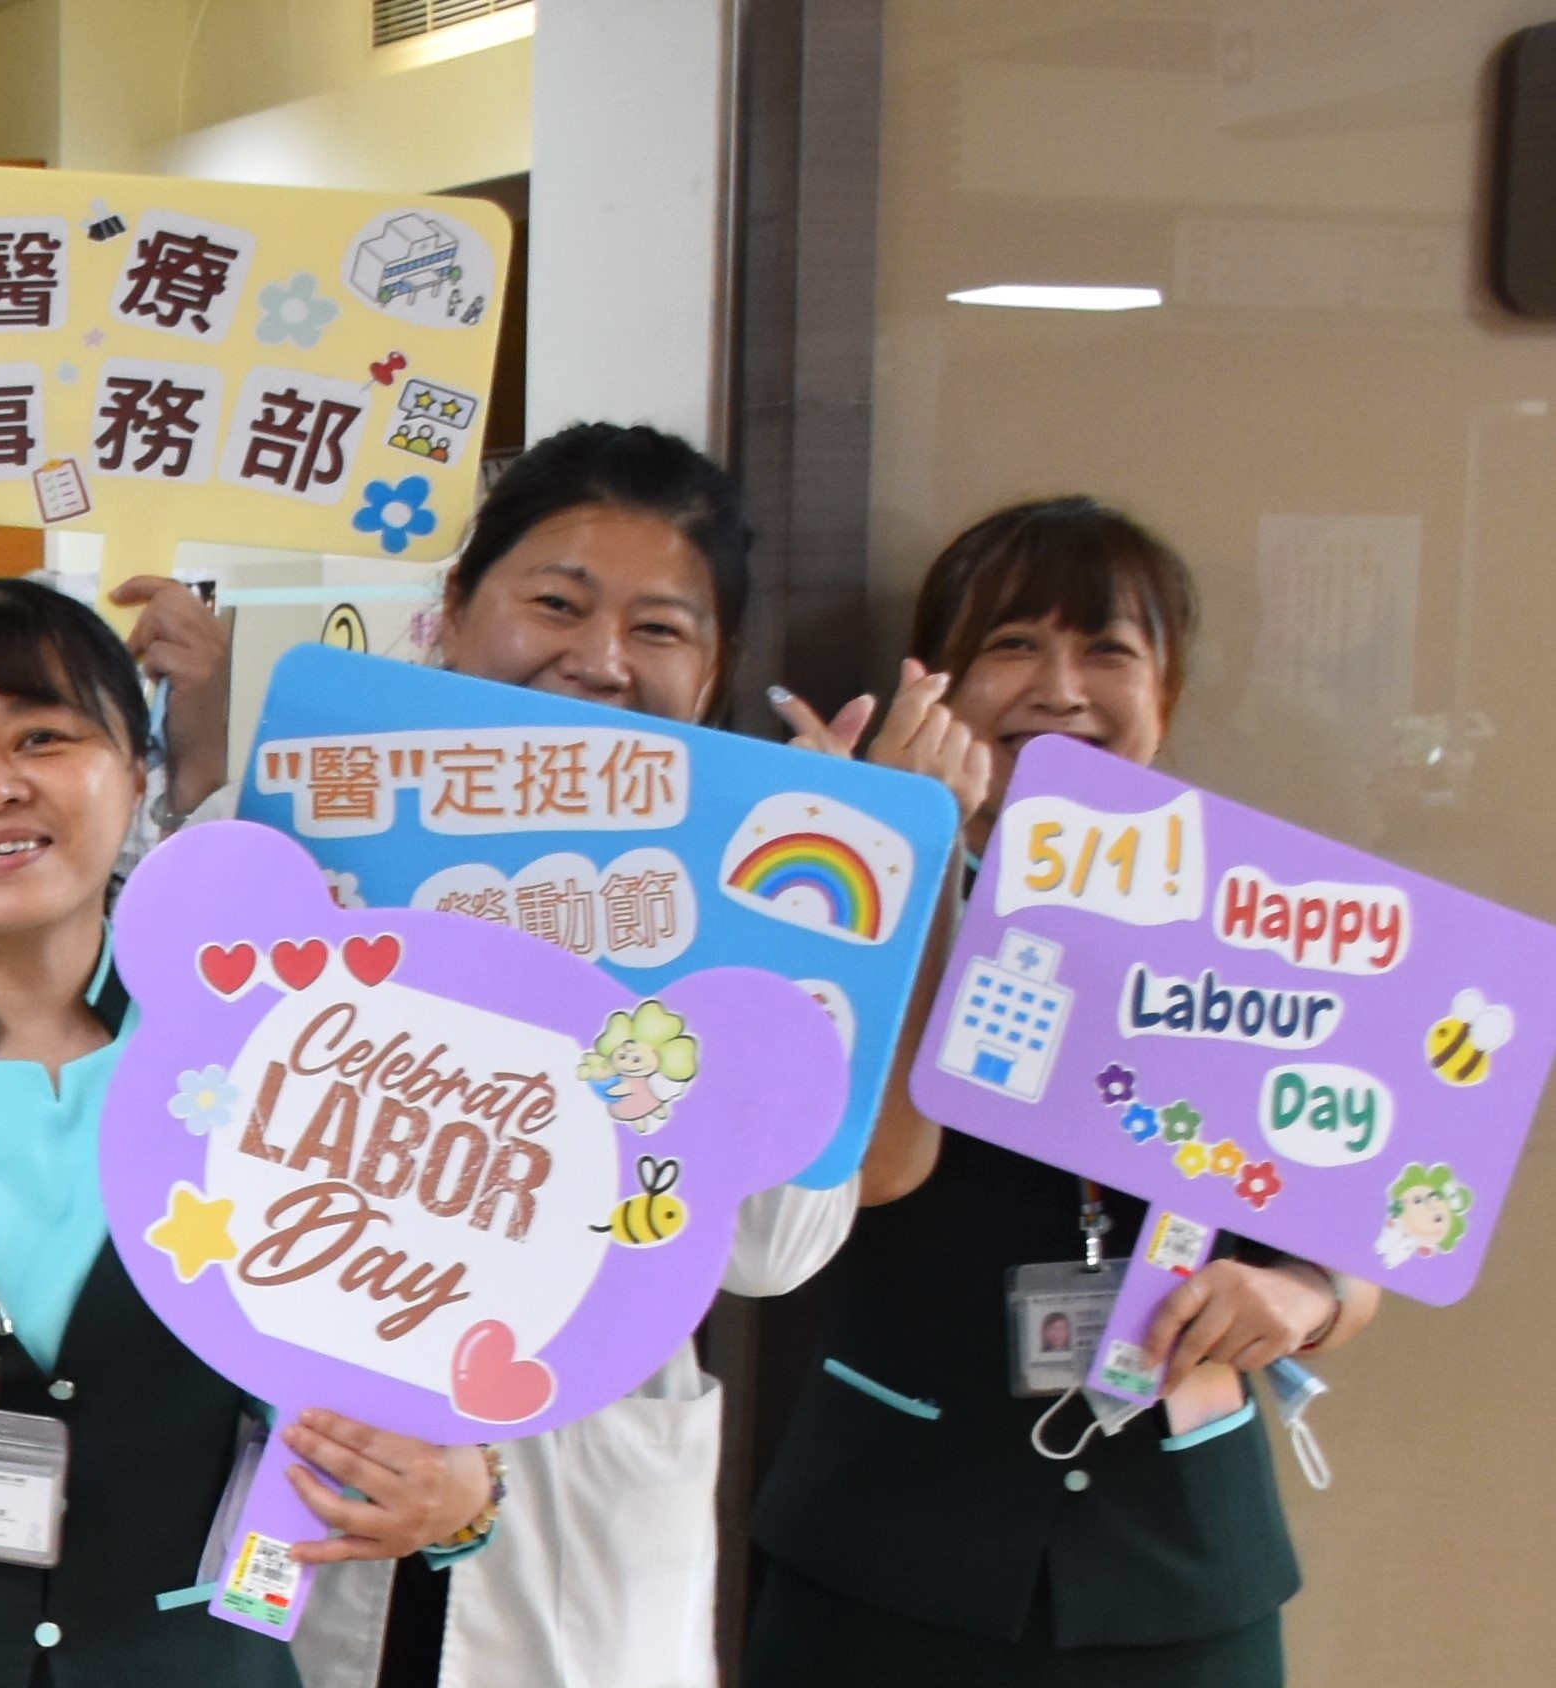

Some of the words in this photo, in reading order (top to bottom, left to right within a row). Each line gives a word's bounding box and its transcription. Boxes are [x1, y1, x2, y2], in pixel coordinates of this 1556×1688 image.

[1223, 878, 1401, 968] Happy
[1131, 967, 1335, 1040] Labour
[291, 1002, 558, 1138] Celebrate
[1271, 1073, 1376, 1152] Day
[238, 1060, 552, 1243] LABOR
[238, 1181, 471, 1342] Day
